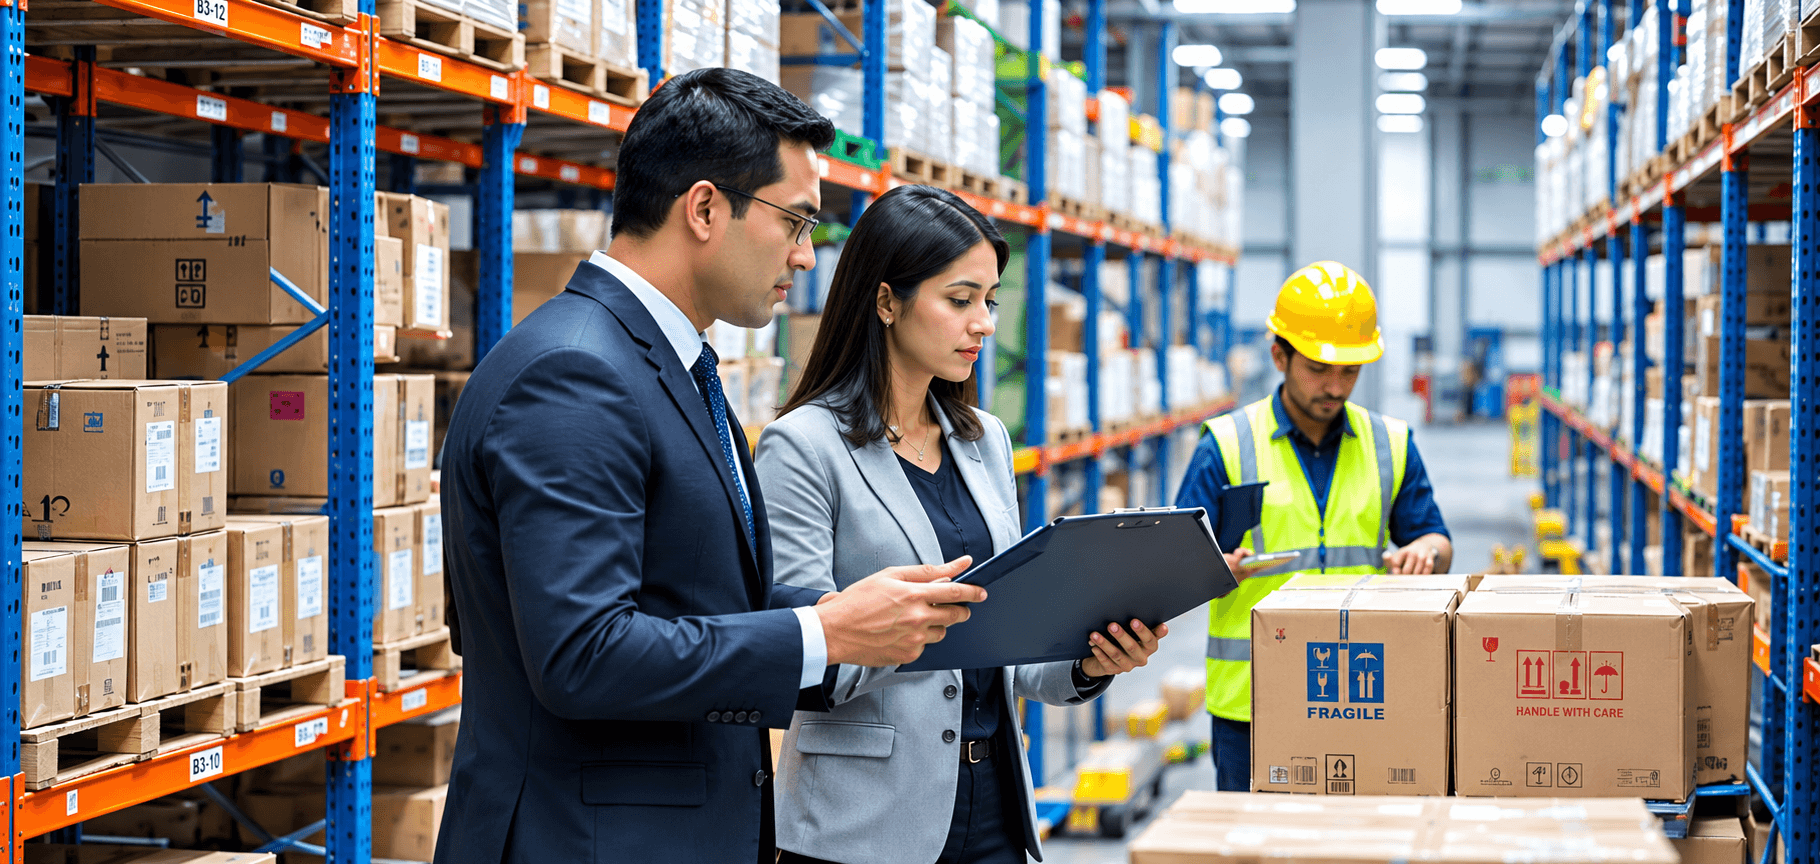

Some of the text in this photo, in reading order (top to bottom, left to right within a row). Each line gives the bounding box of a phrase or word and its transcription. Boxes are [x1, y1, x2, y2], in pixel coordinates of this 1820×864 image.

[197, 0, 226, 21] B3-12
[1307, 706, 1385, 720] FRAGILE
[1516, 706, 1624, 718] HANDLE WITH CARE
[193, 752, 220, 775] B3-10
